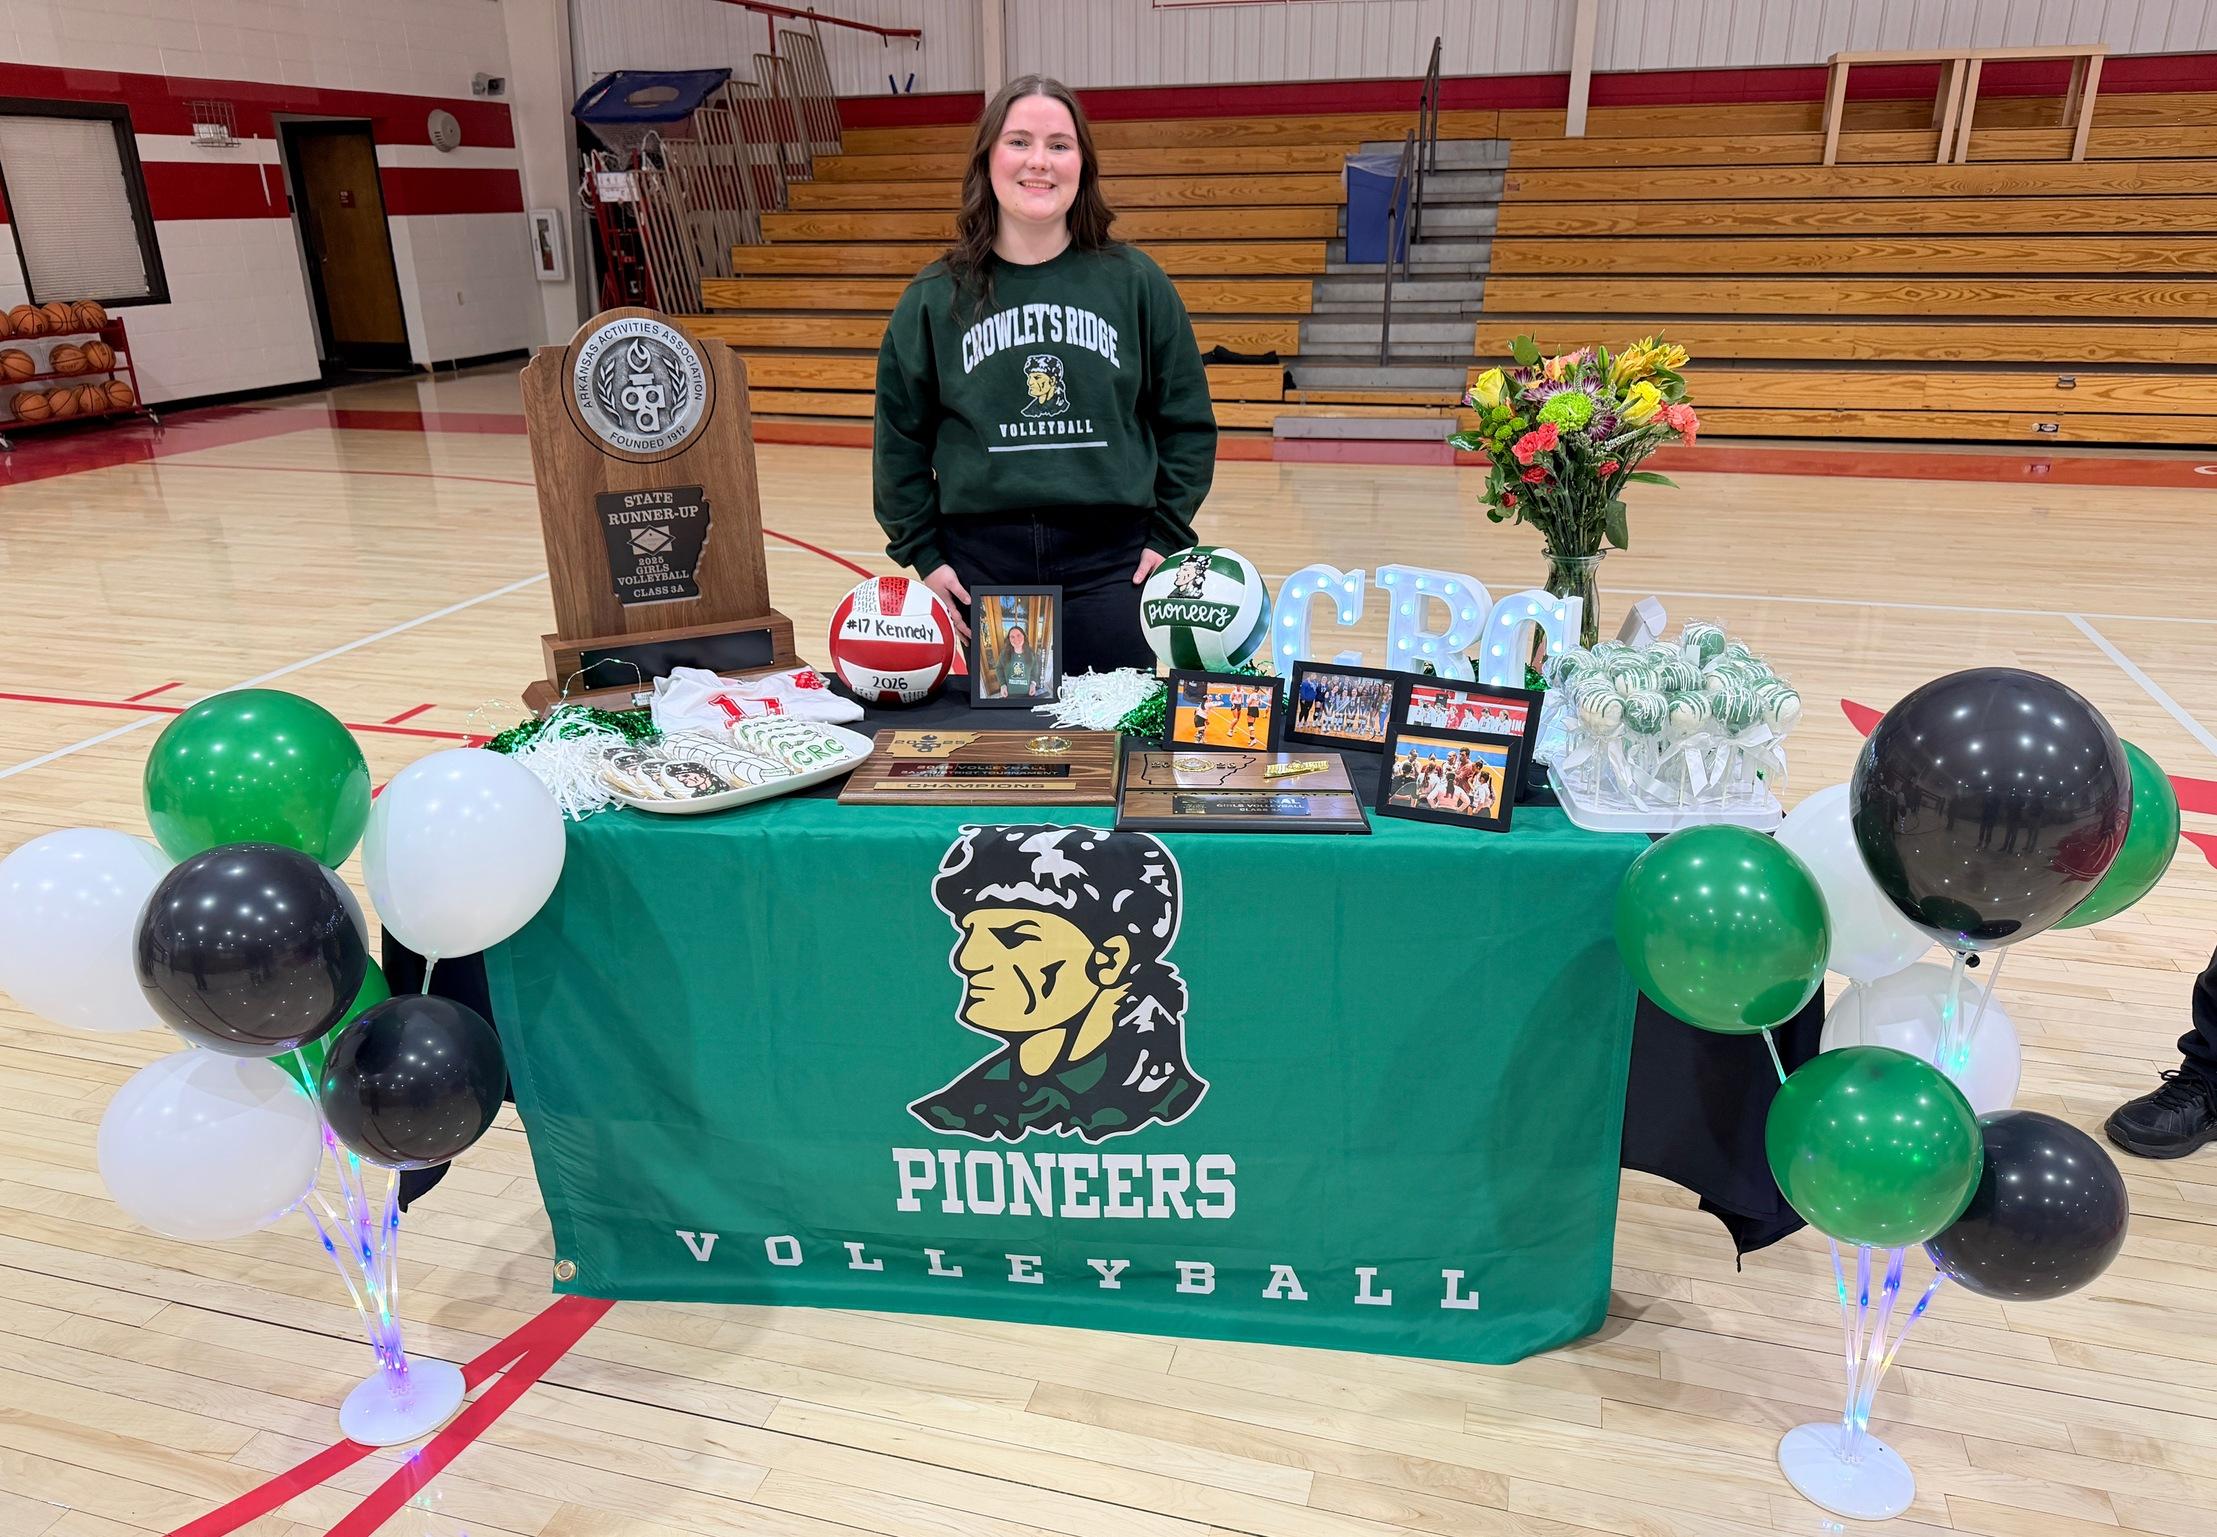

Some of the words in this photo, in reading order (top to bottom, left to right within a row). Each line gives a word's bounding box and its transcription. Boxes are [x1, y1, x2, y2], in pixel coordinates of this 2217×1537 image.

[962, 303, 1062, 374] CROWLEY'S
[1065, 306, 1121, 369] RIDGE
[579, 344, 599, 409] ARKANSAS
[598, 322, 659, 346] ACTIVITIES
[661, 331, 704, 401] ASSOCIATION
[610, 431, 664, 449] FOUNDED
[667, 425, 687, 443] 1912
[999, 419, 1094, 438] VOLLEYBALL
[624, 492, 673, 508] STATE
[608, 505, 699, 525] RUNNER-UP
[636, 563, 670, 575] GIRLS
[638, 556, 664, 566] 2025
[617, 570, 689, 586] VOLLEYBALL
[633, 586, 669, 598] CLASS
[670, 584, 685, 594] 3A
[1148, 600, 1231, 627] pioneers
[846, 618, 871, 634] #17
[875, 619, 934, 642] Kennedy
[872, 676, 908, 690] 2026
[793, 738, 845, 766] CRC
[892, 1147, 1236, 1219] PIONEERS
[675, 1229, 1479, 1311] VOLLEYBALL
